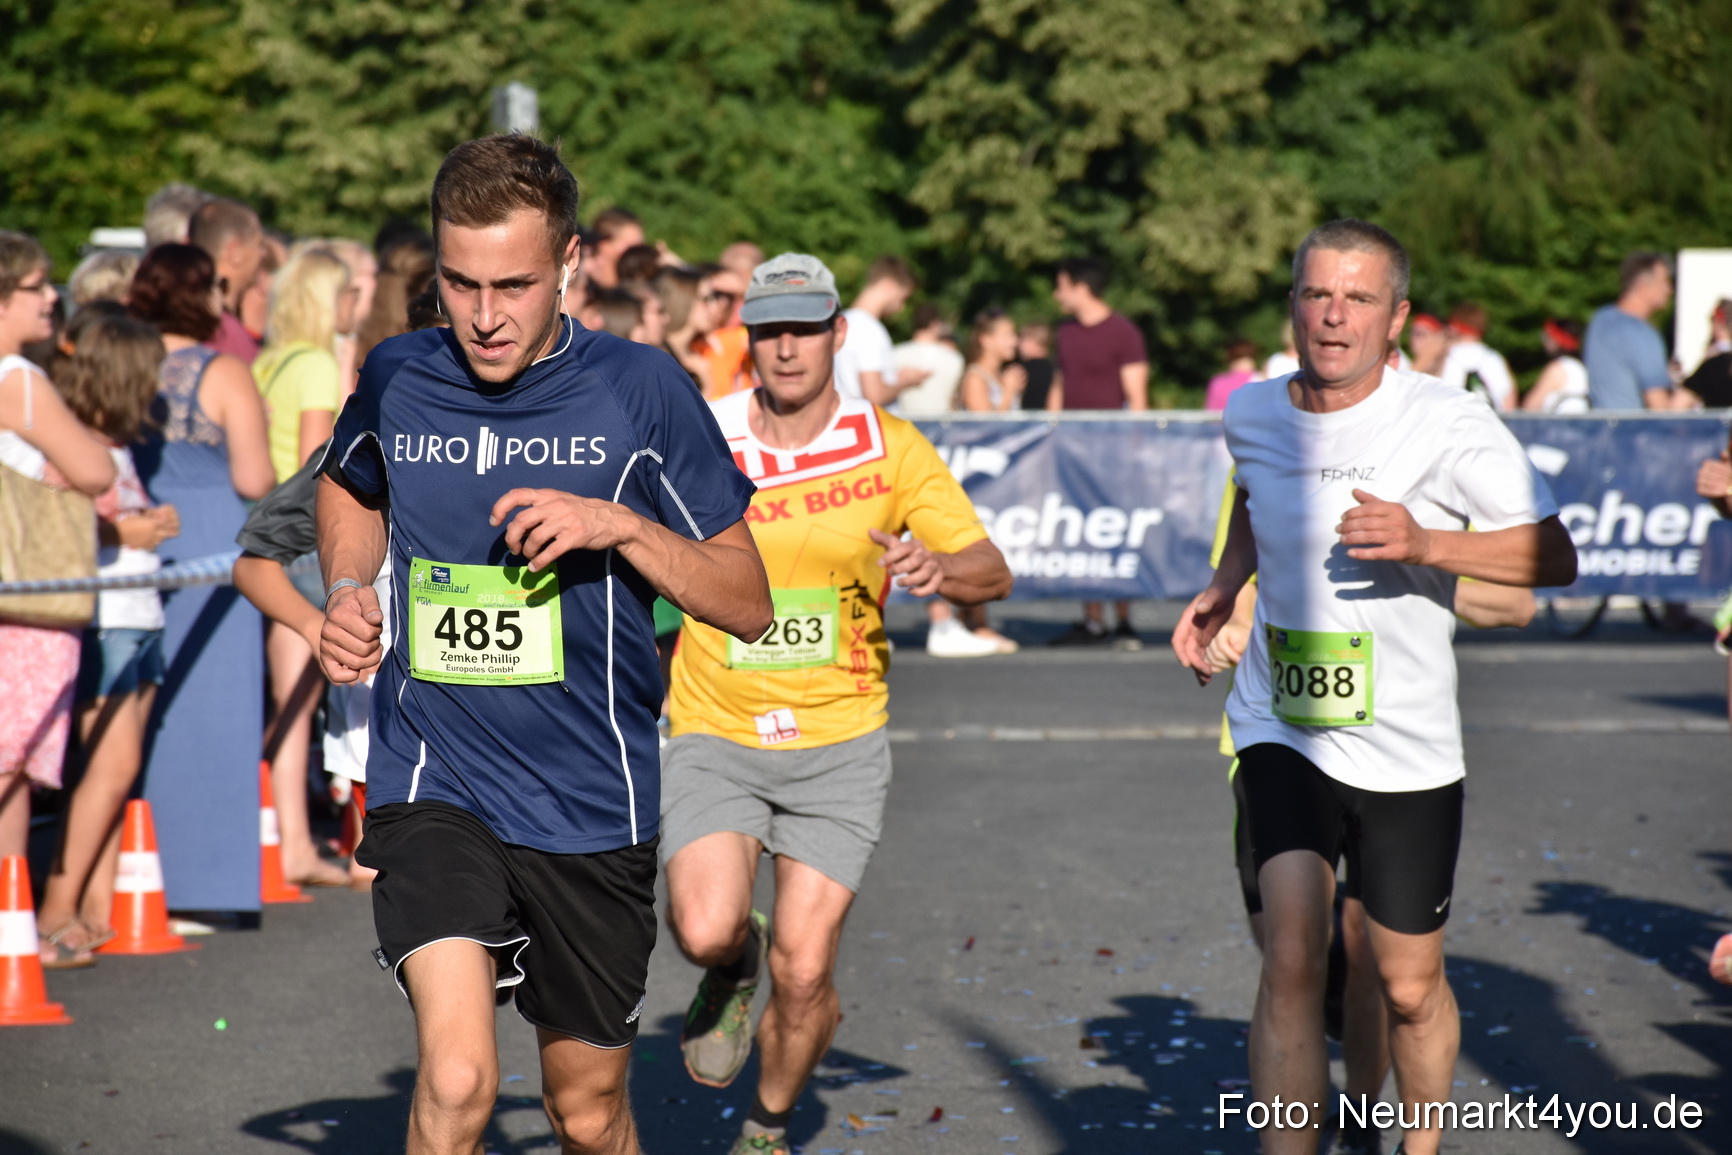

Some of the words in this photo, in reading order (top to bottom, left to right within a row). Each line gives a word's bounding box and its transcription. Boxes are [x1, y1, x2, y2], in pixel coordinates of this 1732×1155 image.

[394, 433, 470, 464] EURO
[504, 436, 607, 465] POLES
[743, 498, 794, 525] AX
[803, 473, 893, 515] BÖGL
[976, 492, 1164, 550] scher
[1559, 489, 1721, 547] cher
[1010, 551, 1141, 579] MOBILE
[1577, 548, 1703, 577] MOBILE
[423, 579, 470, 594] firmenlauf
[476, 593, 505, 604] 2018
[434, 606, 523, 651] 485
[760, 617, 824, 646] 263
[440, 651, 478, 664] Zemke
[481, 653, 521, 666] Phillip
[445, 663, 486, 674] Europoles
[488, 665, 514, 674] GmbH
[1273, 660, 1355, 699] 2088
